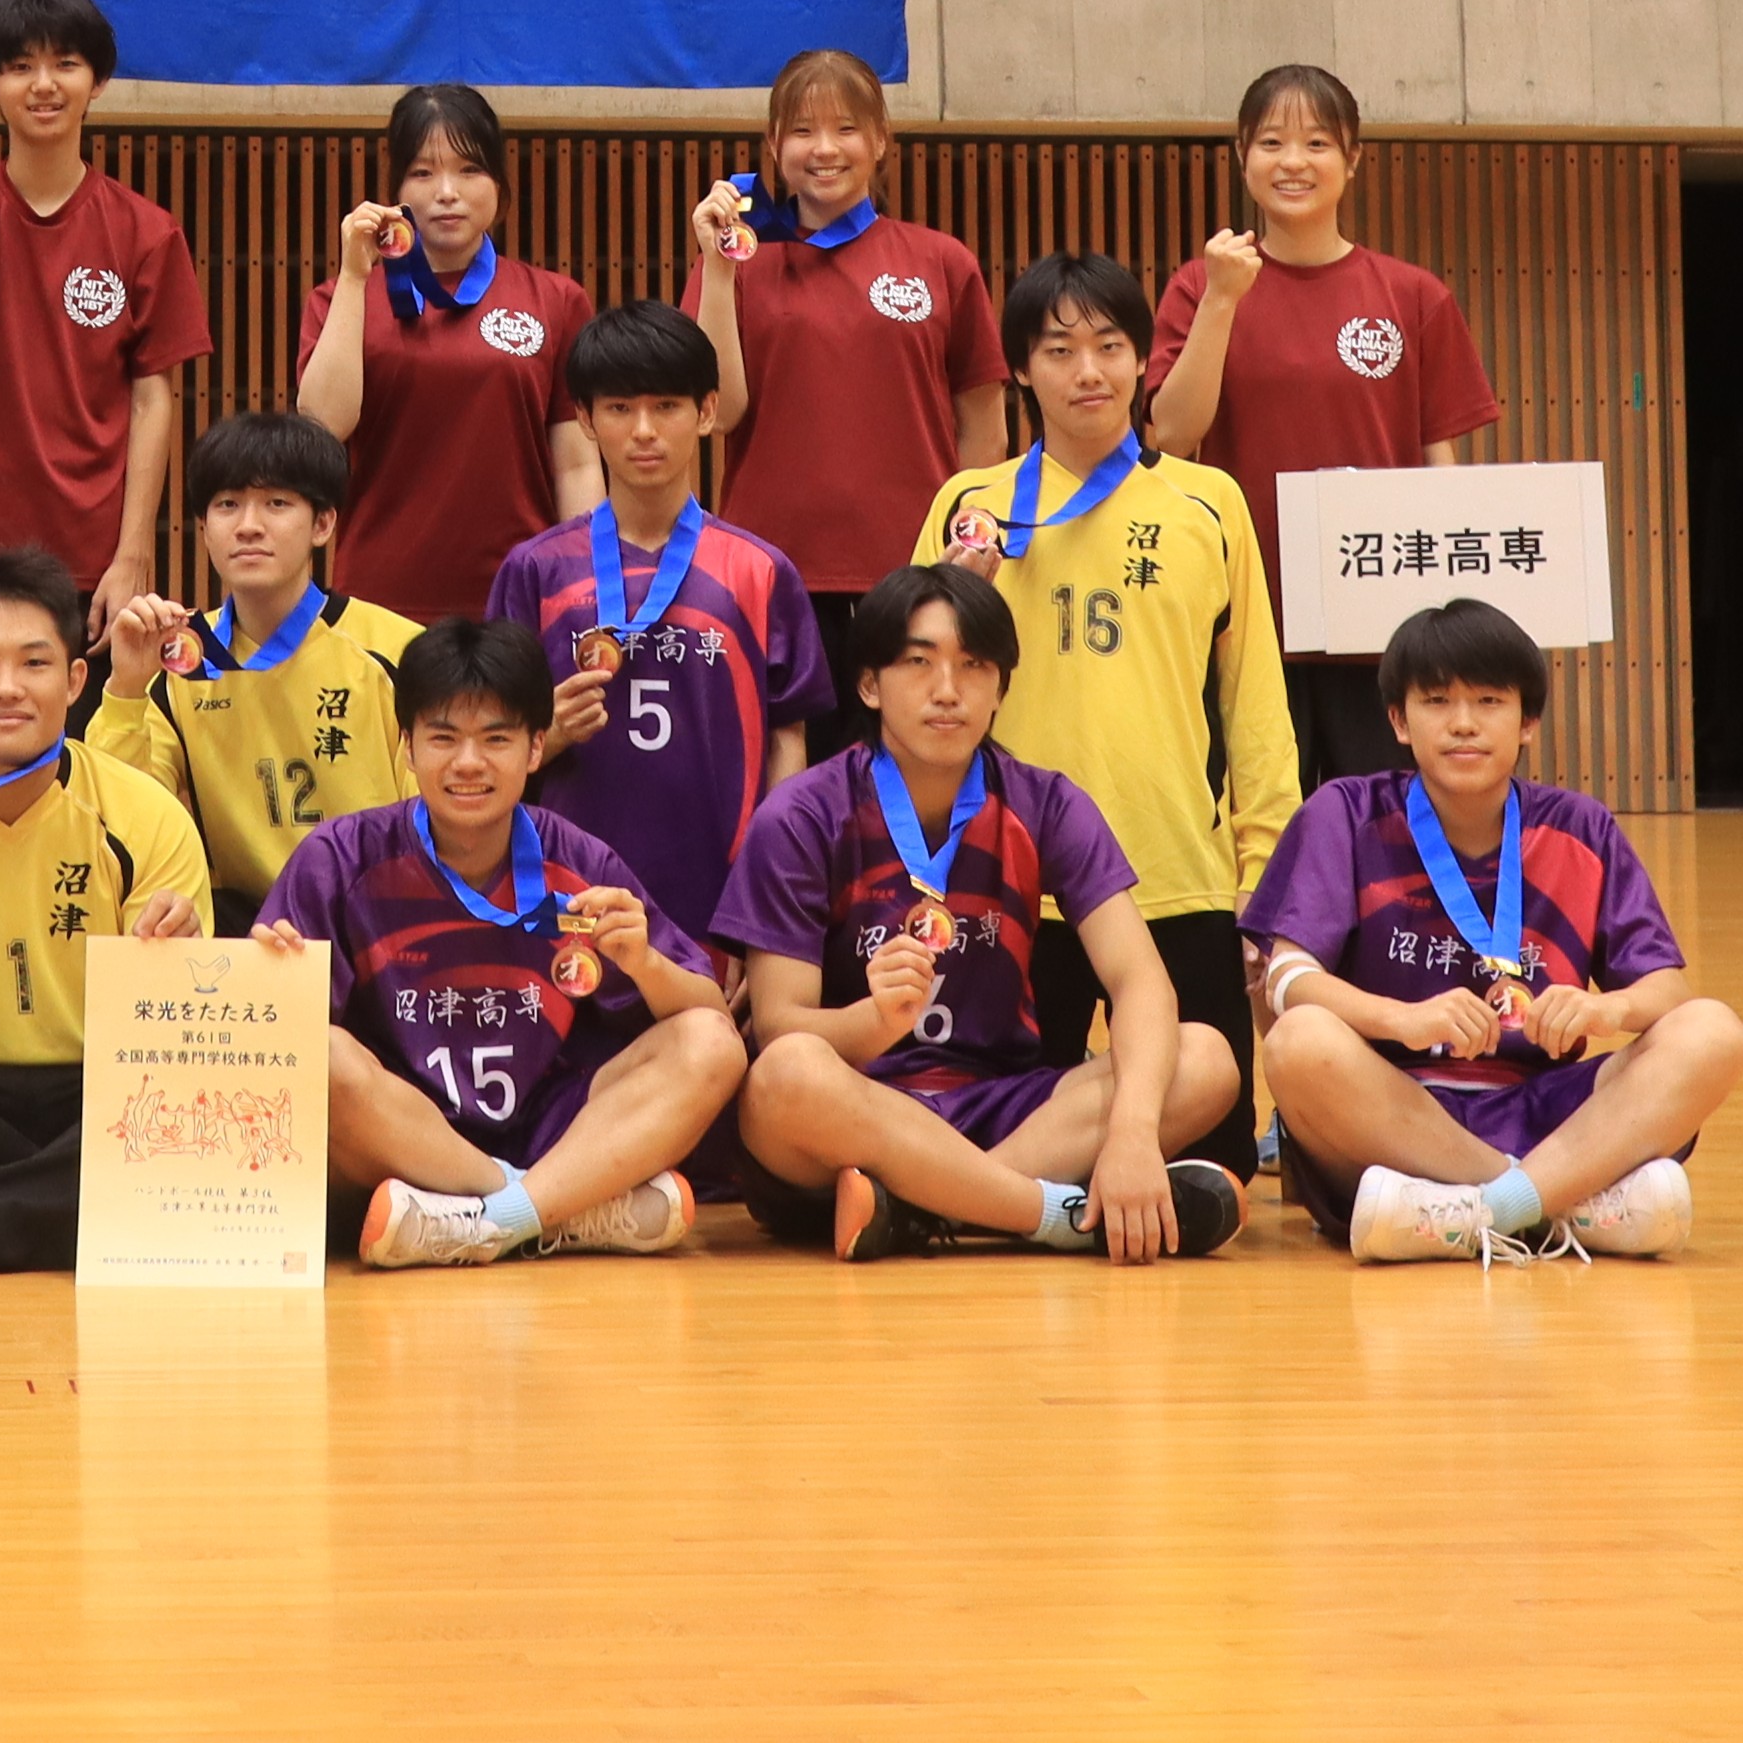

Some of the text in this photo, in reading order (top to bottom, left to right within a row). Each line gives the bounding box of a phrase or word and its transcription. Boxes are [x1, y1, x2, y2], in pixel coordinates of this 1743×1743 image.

[67, 286, 120, 303] NUMAZU
[78, 299, 106, 312] HBT
[82, 279, 106, 291] NIT
[1342, 337, 1397, 353] NUMAZU
[1359, 329, 1385, 340] NIT
[1123, 520, 1162, 592] 沼津
[1339, 526, 1548, 578] 沼津高専
[571, 625, 728, 666] 津高専
[1051, 584, 1123, 657] 16
[314, 687, 352, 763] 沼津
[628, 678, 672, 751] 5
[255, 758, 324, 827] 12
[49, 861, 91, 941] 沼津
[856, 909, 1001, 960] 沼高専
[6, 939, 34, 1014] 1
[134, 1000, 278, 1022] 栄光をたたえる
[395, 981, 544, 1029] 沼津高専
[913, 974, 953, 1044] 6
[115, 1049, 298, 1067] 全国高等専門学校体育大会
[182, 1031, 231, 1044] 第61回
[426, 1044, 516, 1122] 15
